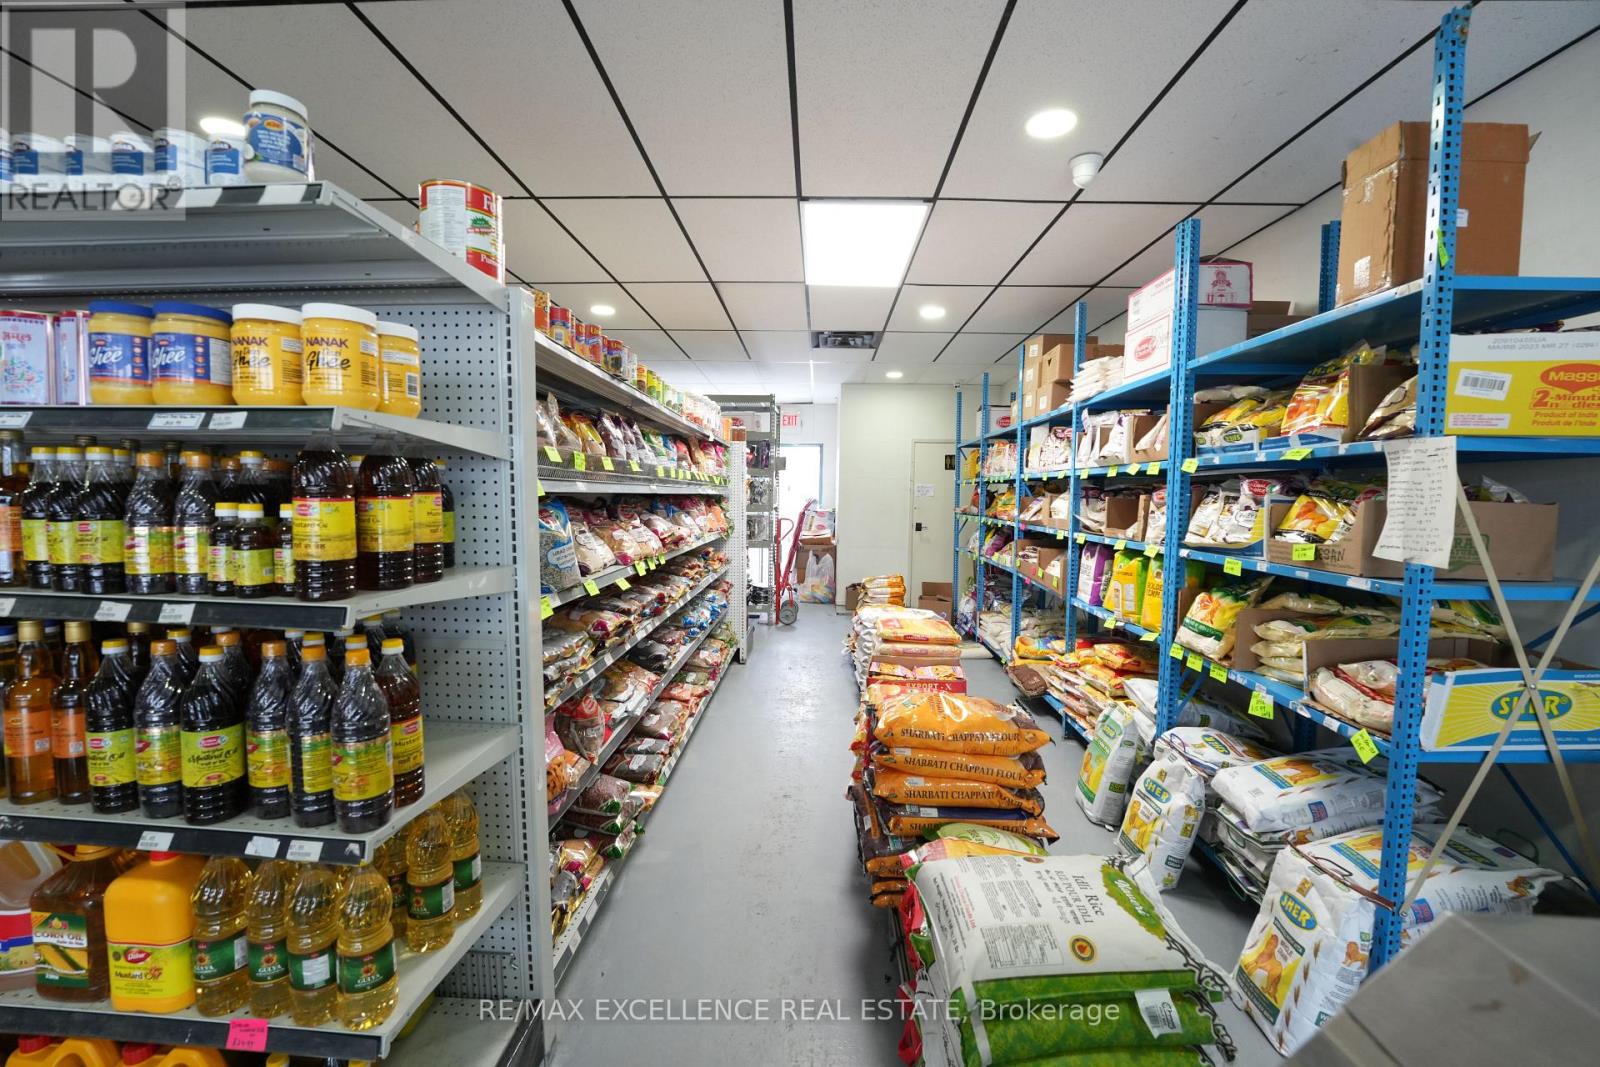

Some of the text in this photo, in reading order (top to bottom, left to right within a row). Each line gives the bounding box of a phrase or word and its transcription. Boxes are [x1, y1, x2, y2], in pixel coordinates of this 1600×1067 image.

[306, 337, 348, 348] NANAK
[306, 351, 351, 371] Ghee
[1548, 371, 1600, 383] Magg
[783, 415, 798, 426] EXIT
[1318, 547, 1345, 561] ESAN
[1499, 695, 1559, 716] SR
[903, 757, 948, 769] SHARBATI
[950, 761, 994, 777] CHAPPATI
[904, 790, 949, 800] SHARBATI
[1145, 779, 1169, 801] SHER
[1062, 882, 1082, 903] POUR
[1076, 905, 1094, 923] IDLI
[1072, 875, 1105, 916] Idli Rice
[1281, 896, 1310, 927] SHER
[34, 931, 64, 939] CORN
